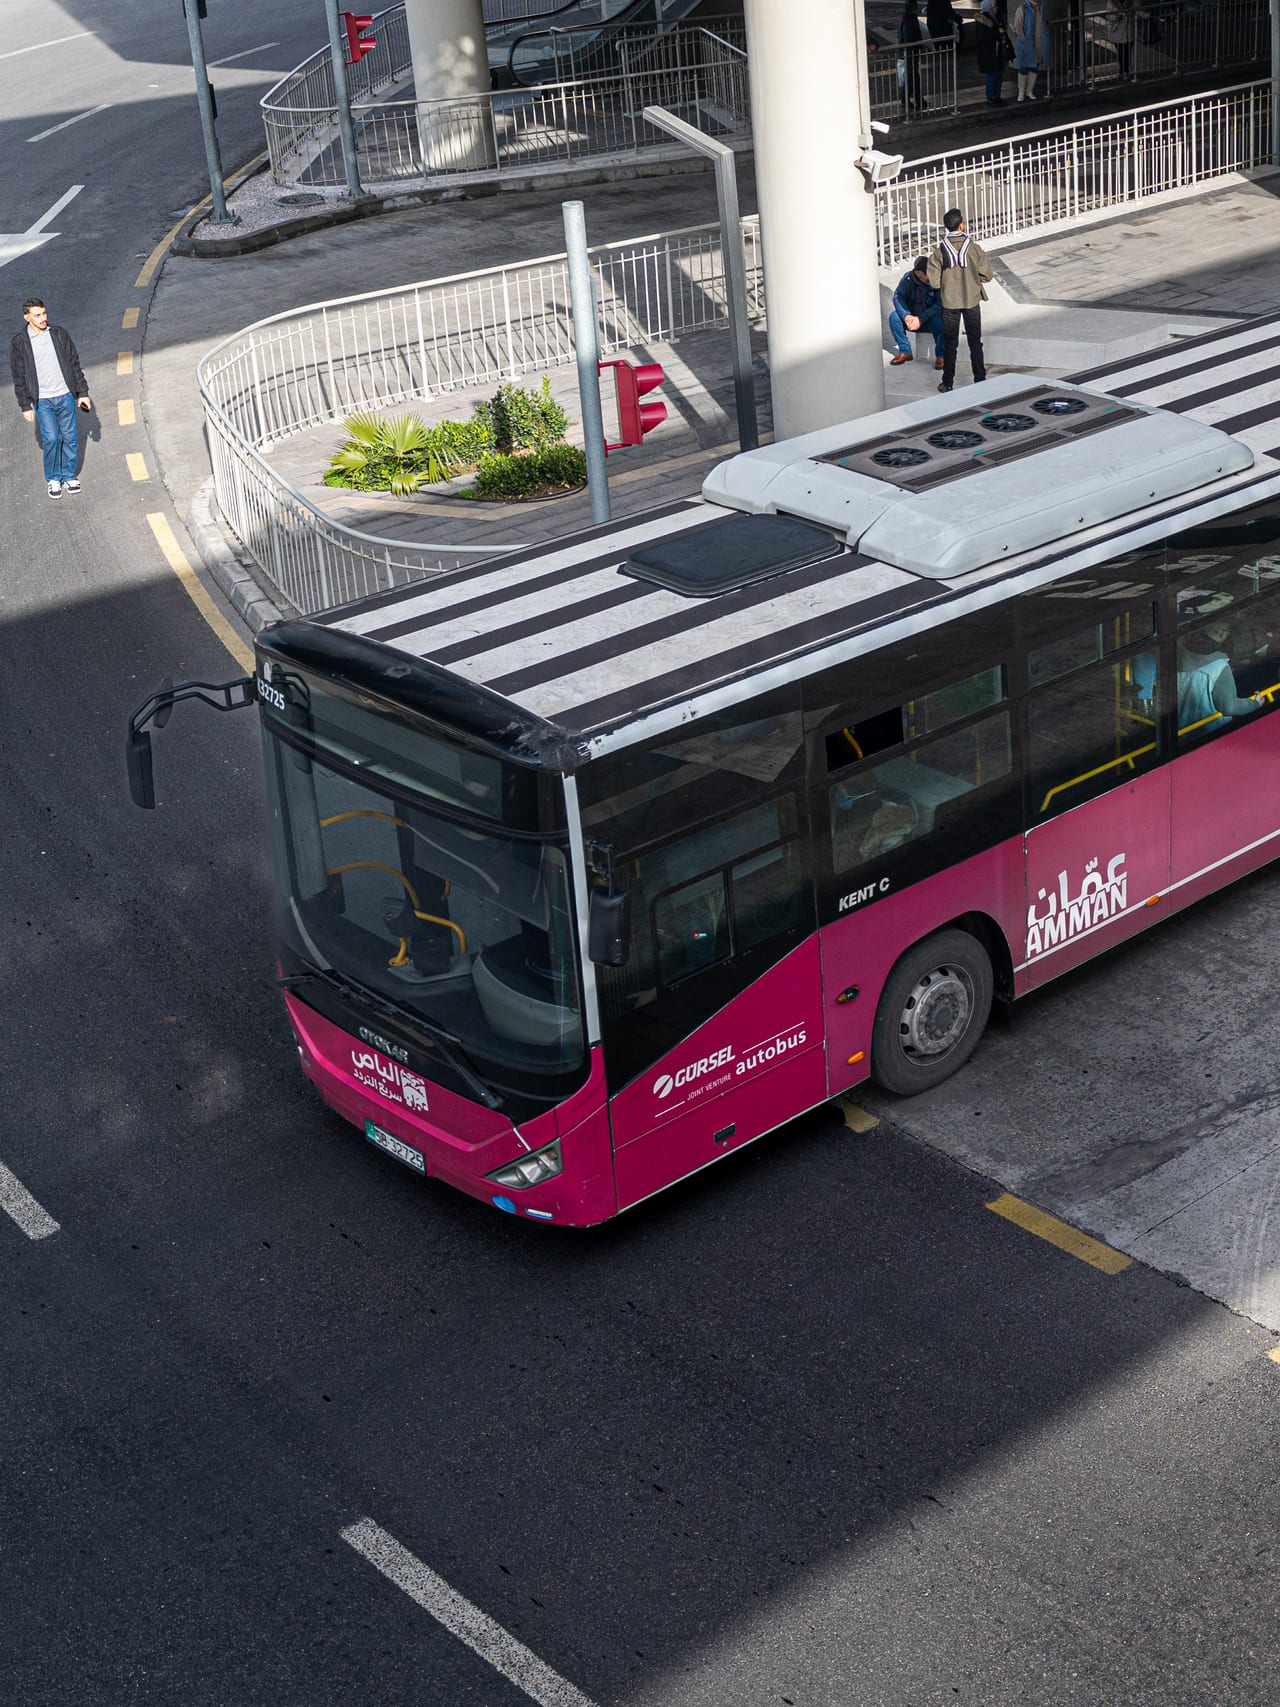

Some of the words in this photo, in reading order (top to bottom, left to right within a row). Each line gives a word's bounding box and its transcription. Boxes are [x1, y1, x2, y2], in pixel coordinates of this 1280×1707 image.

[838, 882, 877, 913] KENT
[879, 877, 890, 892] C
[1026, 878, 1128, 959] AMMAN
[359, 1025, 409, 1064] OTOKAR
[735, 1029, 807, 1076] autobus
[351, 1050, 401, 1086] الباص
[674, 1044, 736, 1088] GÜRSEL
[687, 1087, 704, 1101] JOINT
[705, 1072, 732, 1092] VENTURE
